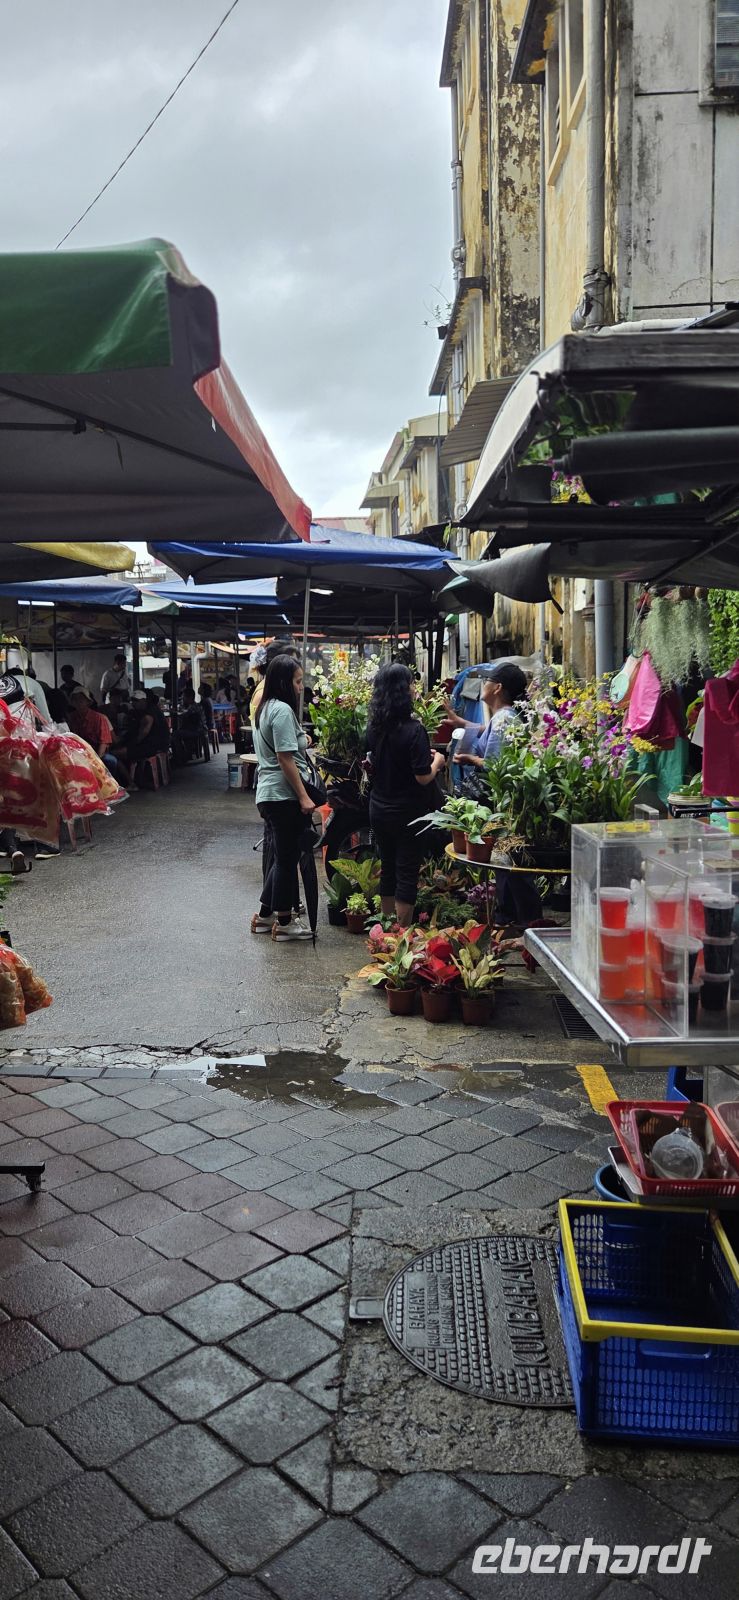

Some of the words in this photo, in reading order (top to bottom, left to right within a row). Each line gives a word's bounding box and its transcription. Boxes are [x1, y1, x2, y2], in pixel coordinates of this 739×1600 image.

[408, 1288, 425, 1330] BAHAYA
[500, 1261, 551, 1367] KUMBAHAN
[427, 1319, 440, 1346] RUANG
